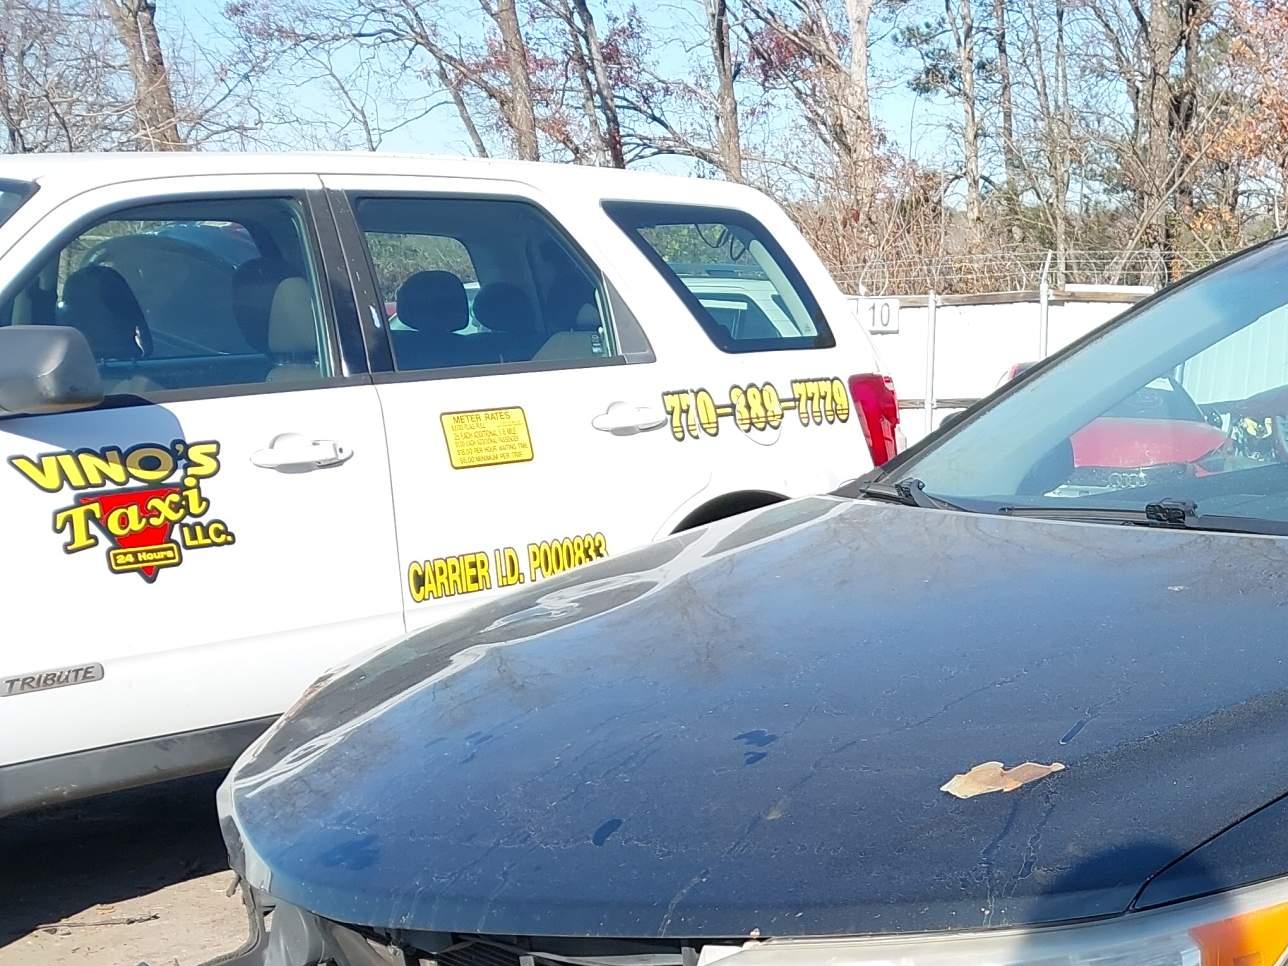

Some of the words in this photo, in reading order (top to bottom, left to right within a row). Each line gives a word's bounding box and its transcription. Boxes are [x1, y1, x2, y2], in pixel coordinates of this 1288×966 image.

[868, 302, 890, 327] 10
[452, 414, 482, 424] METER
[484, 411, 511, 422] RATES
[9, 440, 220, 491] VINO'S
[54, 476, 209, 554] Taxi
[182, 520, 235, 549] LLC.
[115, 553, 135, 565] 24
[137, 550, 175, 562] Hours
[408, 552, 492, 603] CARRIER
[494, 547, 525, 588] I.D.
[5, 665, 96, 694] TRIBUTE
